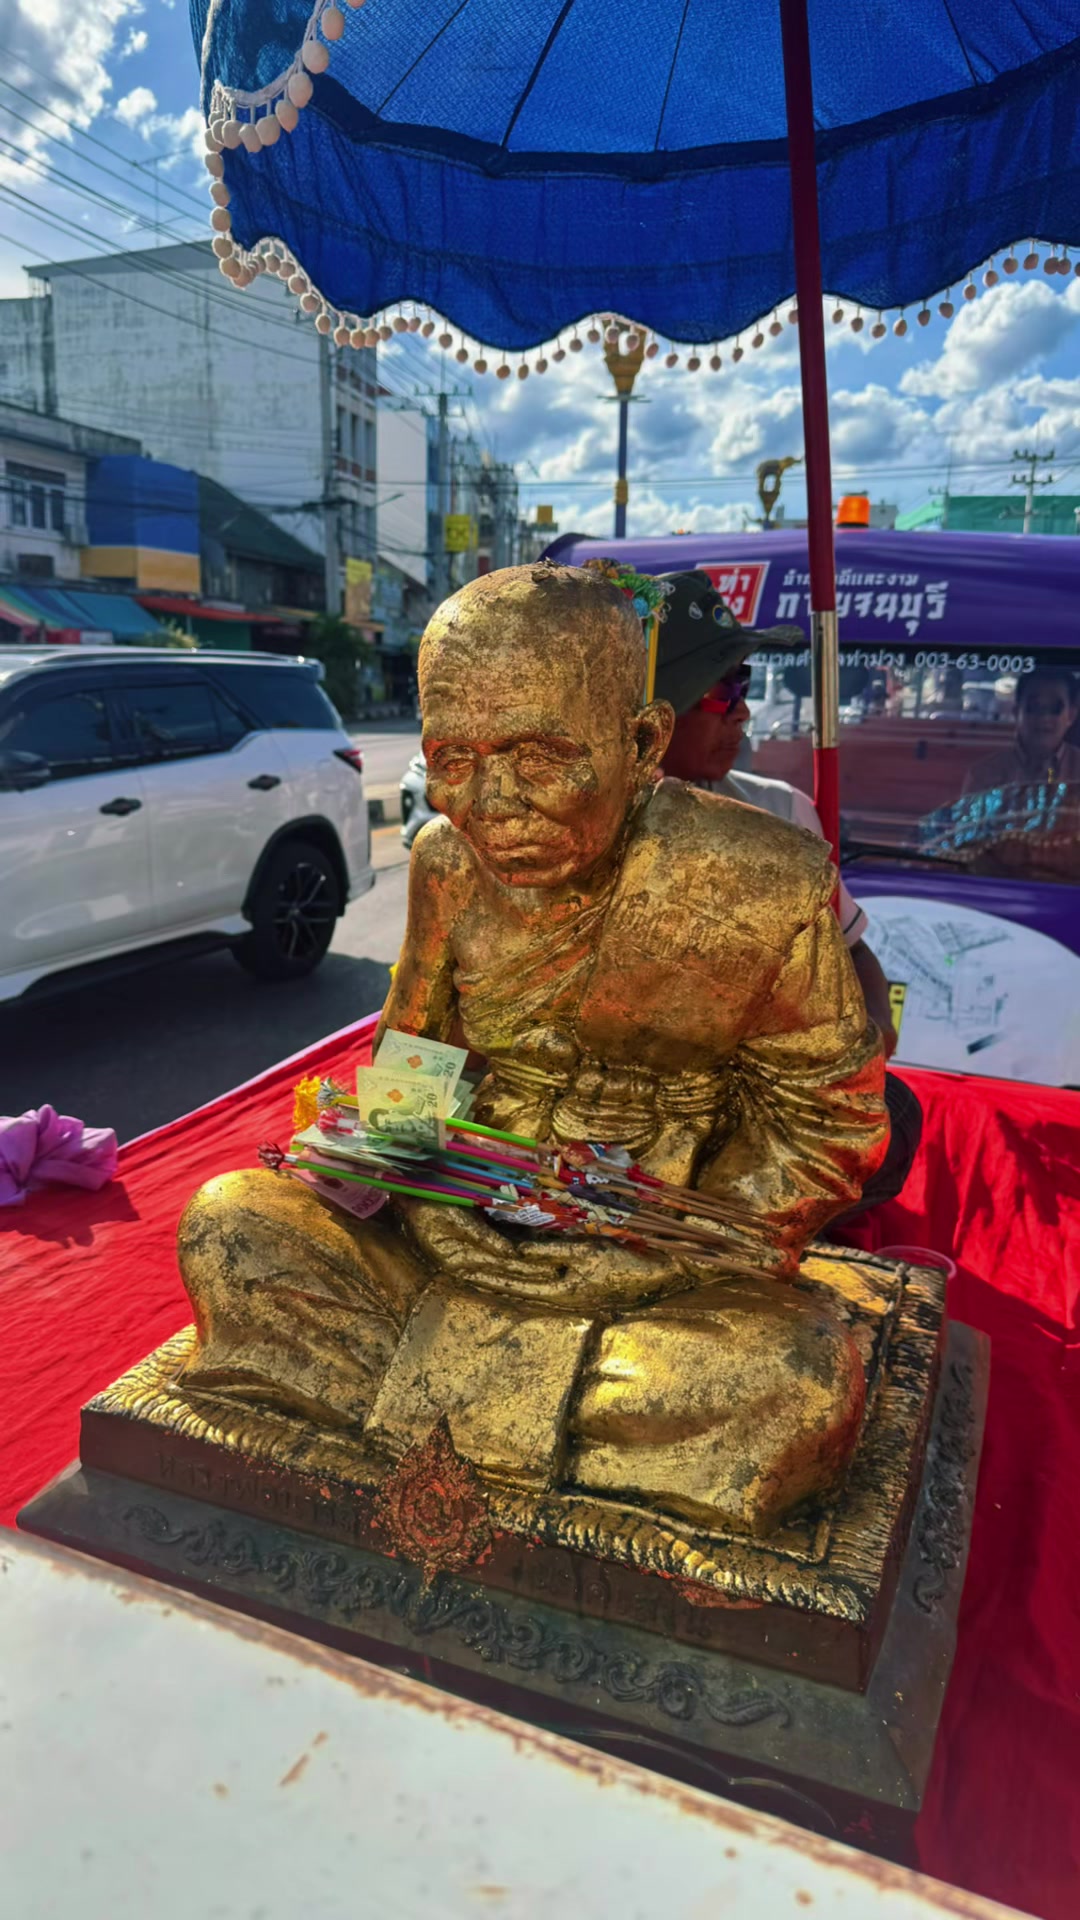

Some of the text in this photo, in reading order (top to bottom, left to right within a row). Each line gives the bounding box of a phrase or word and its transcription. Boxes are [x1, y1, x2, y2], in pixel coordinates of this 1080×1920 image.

[914, 651, 1036, 674] 003-63-0003
[443, 1061, 456, 1078] 20
[426, 1092, 438, 1108] 20
